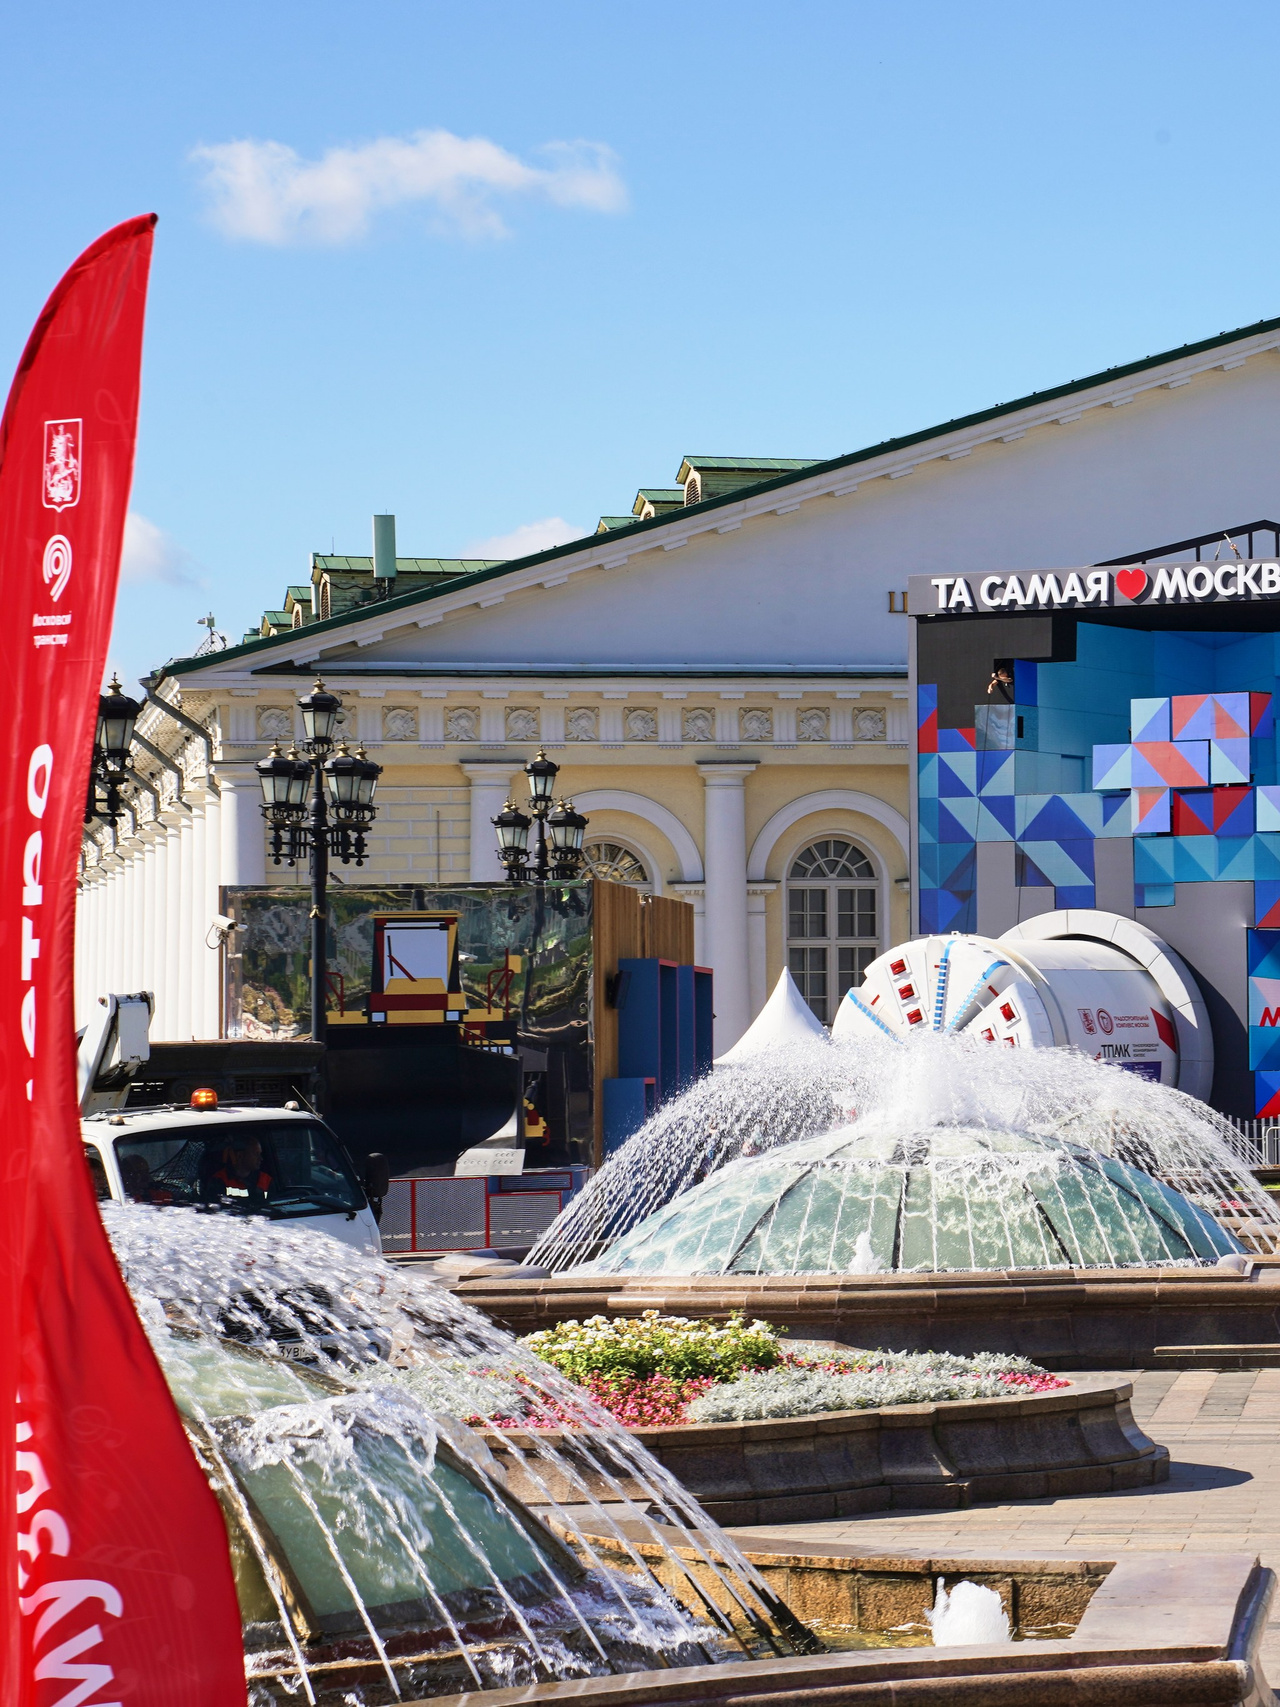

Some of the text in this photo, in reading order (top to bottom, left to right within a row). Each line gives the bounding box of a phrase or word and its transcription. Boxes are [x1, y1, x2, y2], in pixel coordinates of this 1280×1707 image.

[931, 577, 973, 608] ТА
[980, 570, 1108, 607] САМАЯ
[1101, 1044, 1131, 1058] ТПМК
